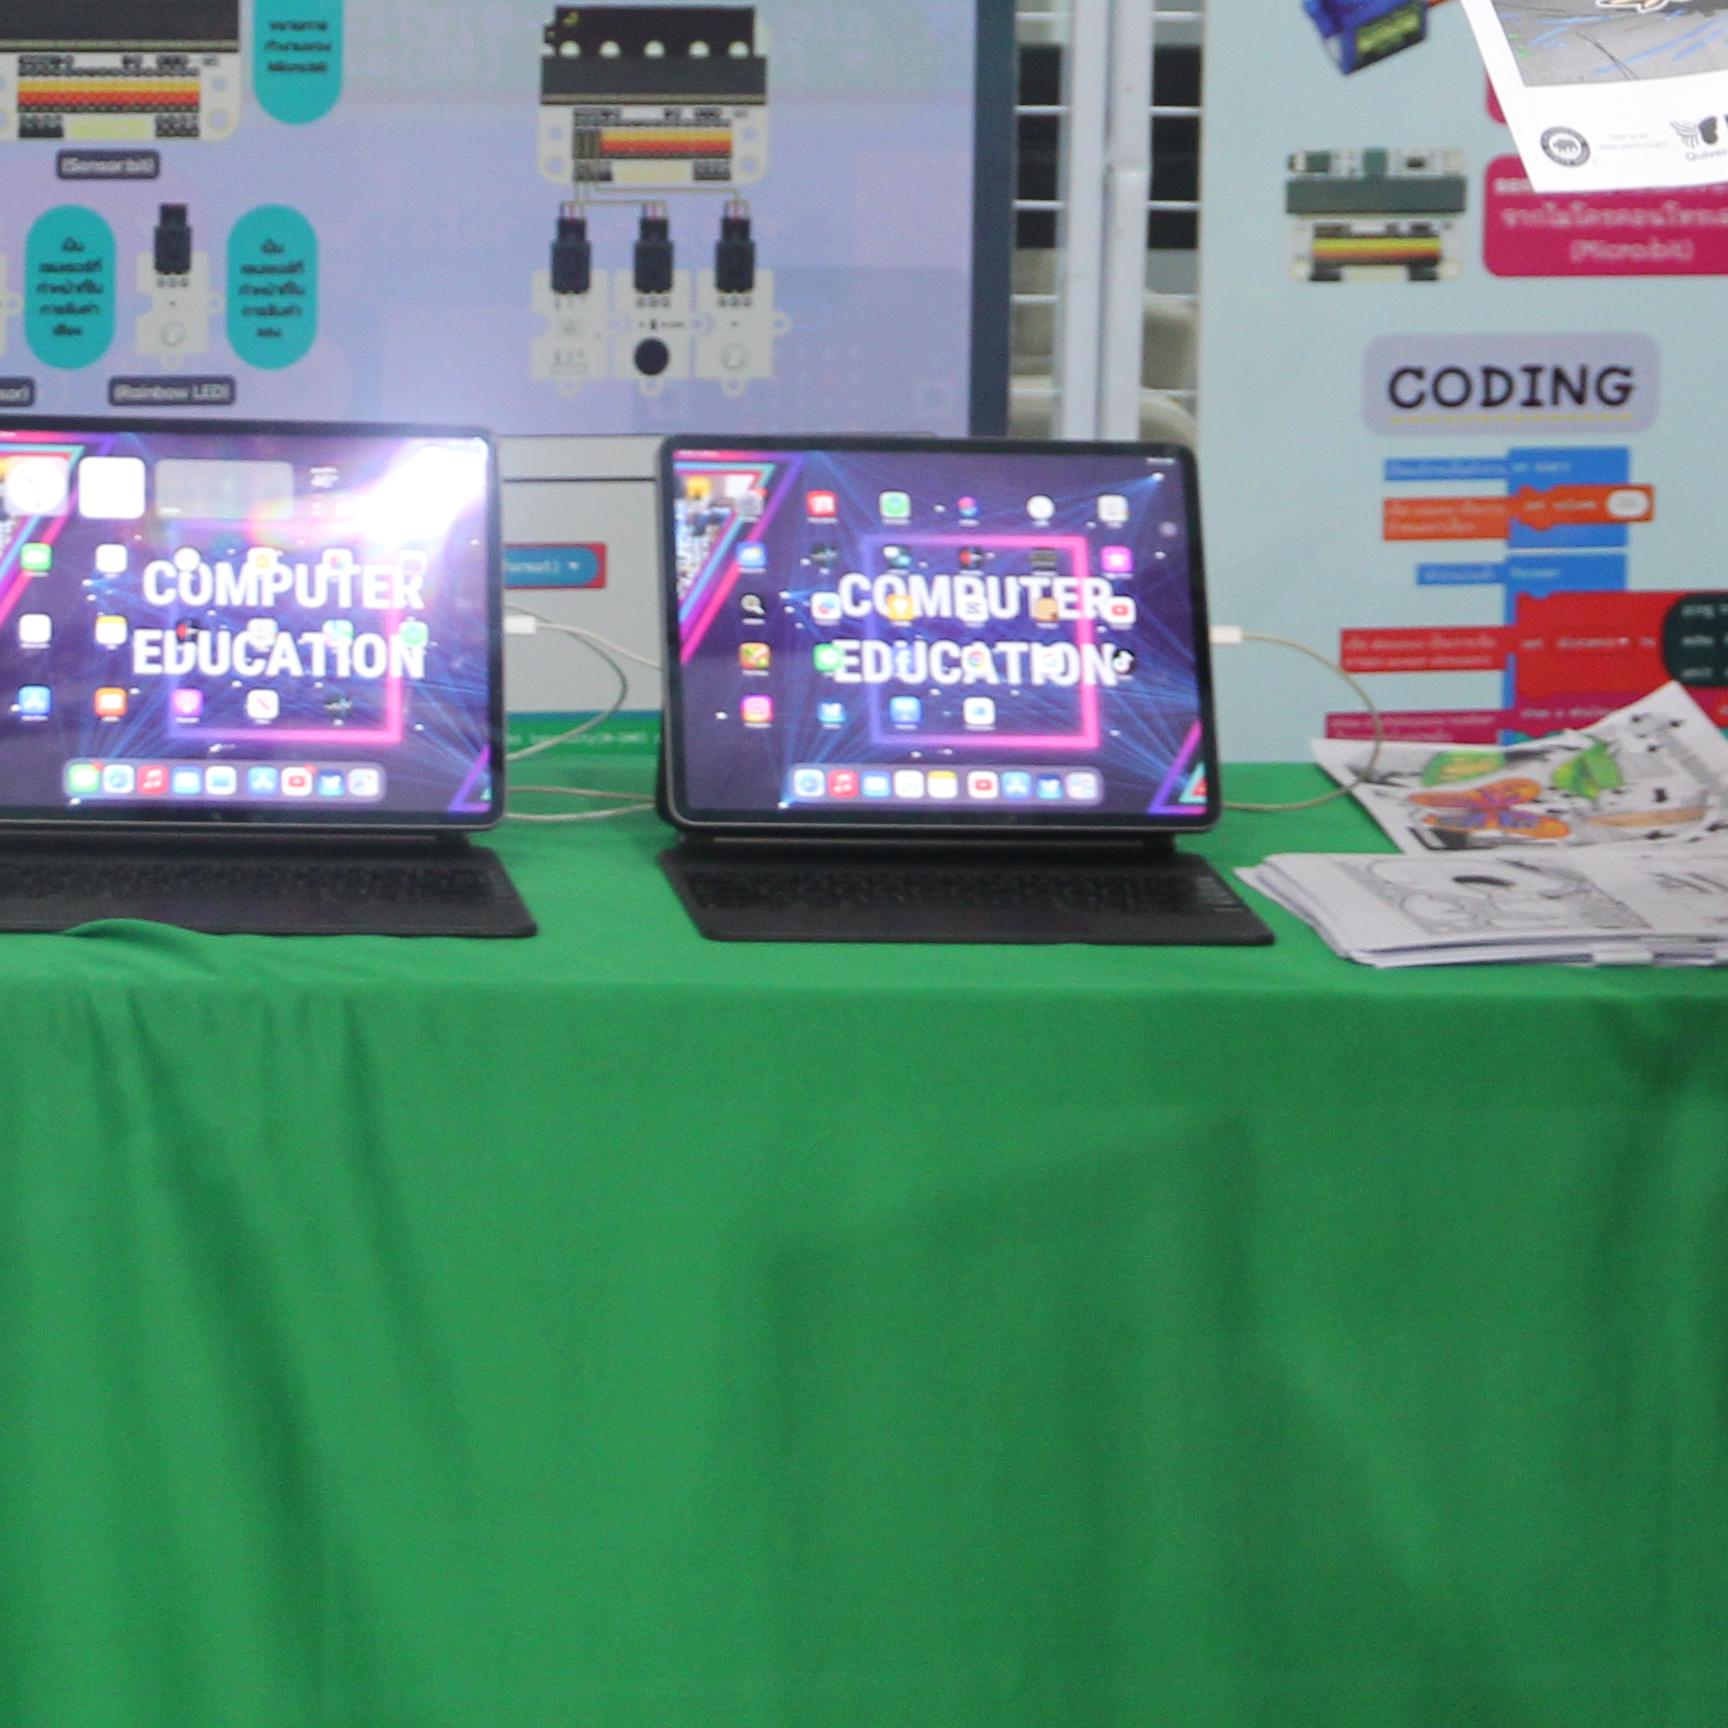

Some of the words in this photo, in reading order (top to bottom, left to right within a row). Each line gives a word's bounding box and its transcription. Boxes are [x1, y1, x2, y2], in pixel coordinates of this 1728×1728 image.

[1386, 365, 1636, 410] CODING
[142, 558, 425, 610] COMPUTER
[837, 572, 1112, 621] COMPUTER
[132, 626, 426, 679] EDUCATION
[832, 639, 1119, 688] EDUCATION
